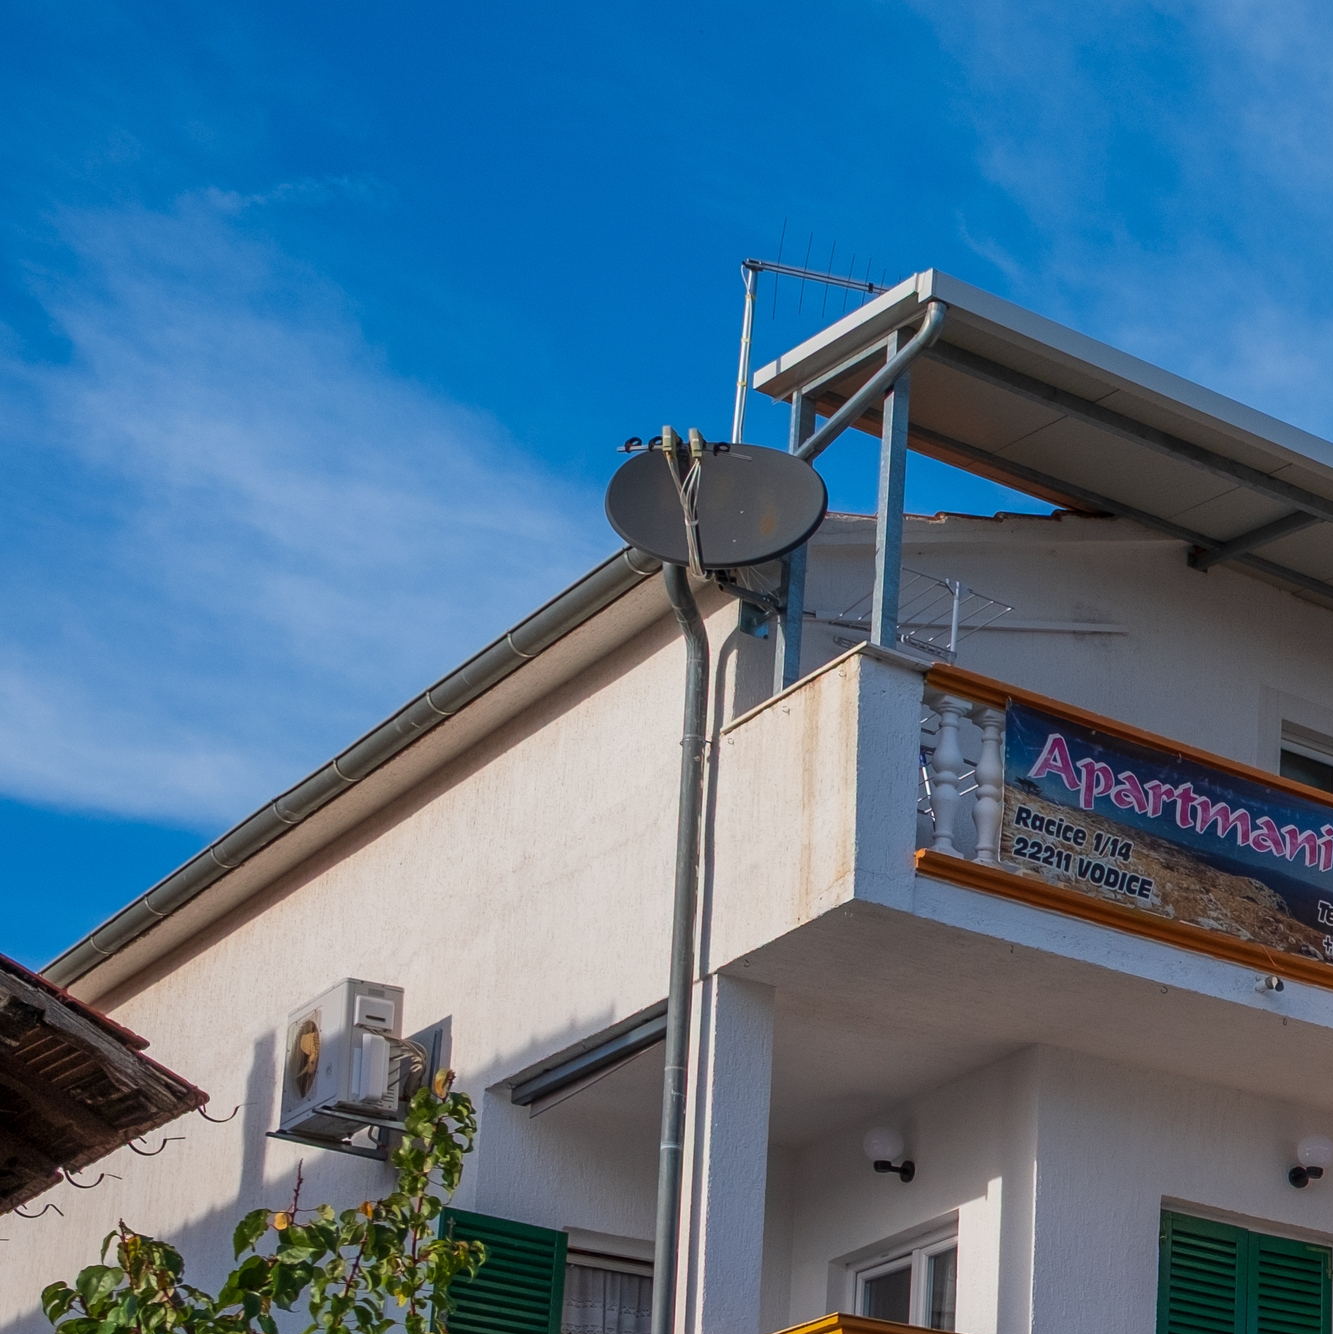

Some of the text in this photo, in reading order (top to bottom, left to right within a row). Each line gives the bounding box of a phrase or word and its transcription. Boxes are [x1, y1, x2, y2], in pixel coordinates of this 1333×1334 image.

[1014, 805, 1134, 862] Racice 1/14
[1012, 836, 1154, 899] 22211 VODICE
